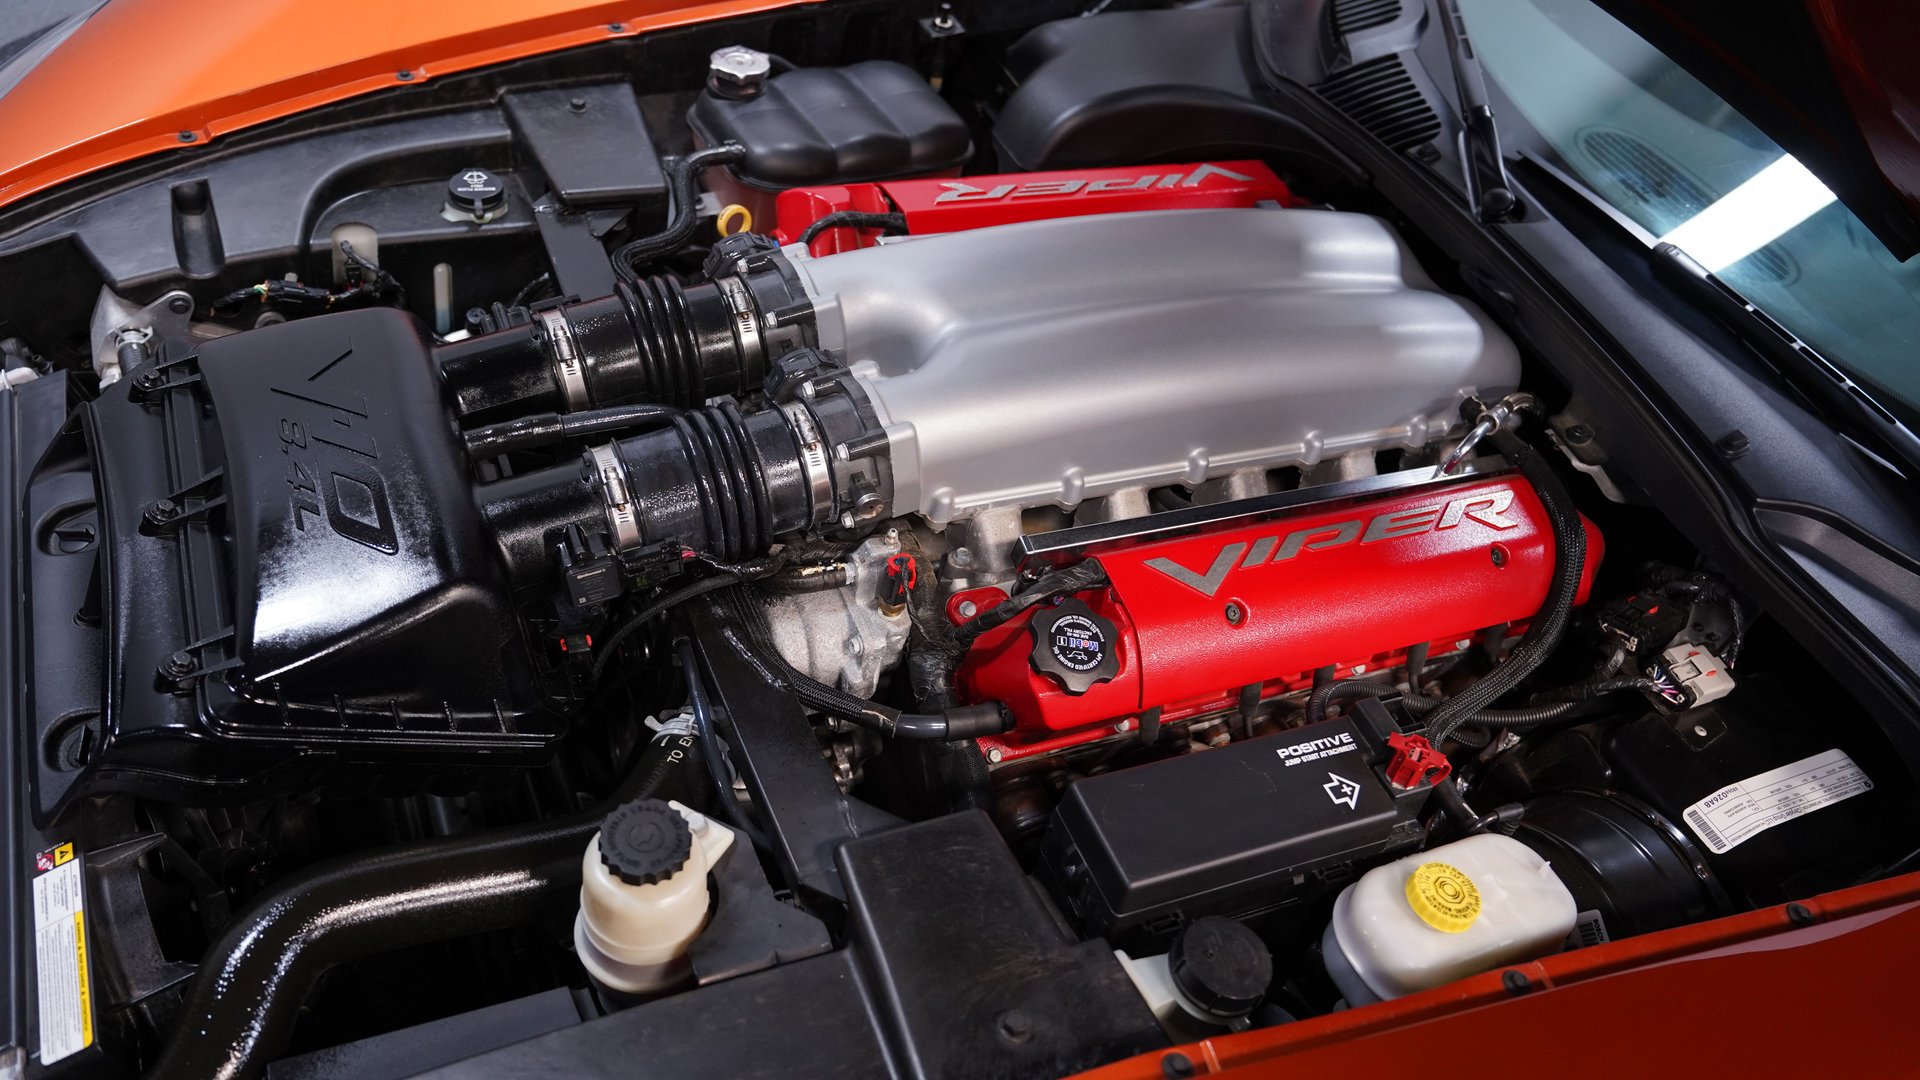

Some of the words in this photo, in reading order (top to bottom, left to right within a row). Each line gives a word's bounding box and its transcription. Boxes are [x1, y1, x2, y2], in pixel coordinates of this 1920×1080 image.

[934, 163, 1254, 205] VIPER
[277, 417, 321, 532] 8.4L
[1143, 489, 1519, 597] VIPER
[1073, 628, 1092, 636] FACTORY
[1052, 645, 1060, 654] OIL
[1068, 637, 1099, 652] Mobil
[1057, 654, 1074, 668] ENGINE
[1075, 659, 1098, 670] CERTIFIED
[1276, 732, 1354, 759] POSITIVE
[666, 749, 684, 763] TO
[1284, 757, 1301, 767] JUMP
[1301, 752, 1320, 762] START
[1319, 743, 1358, 758] ATTACHMENT
